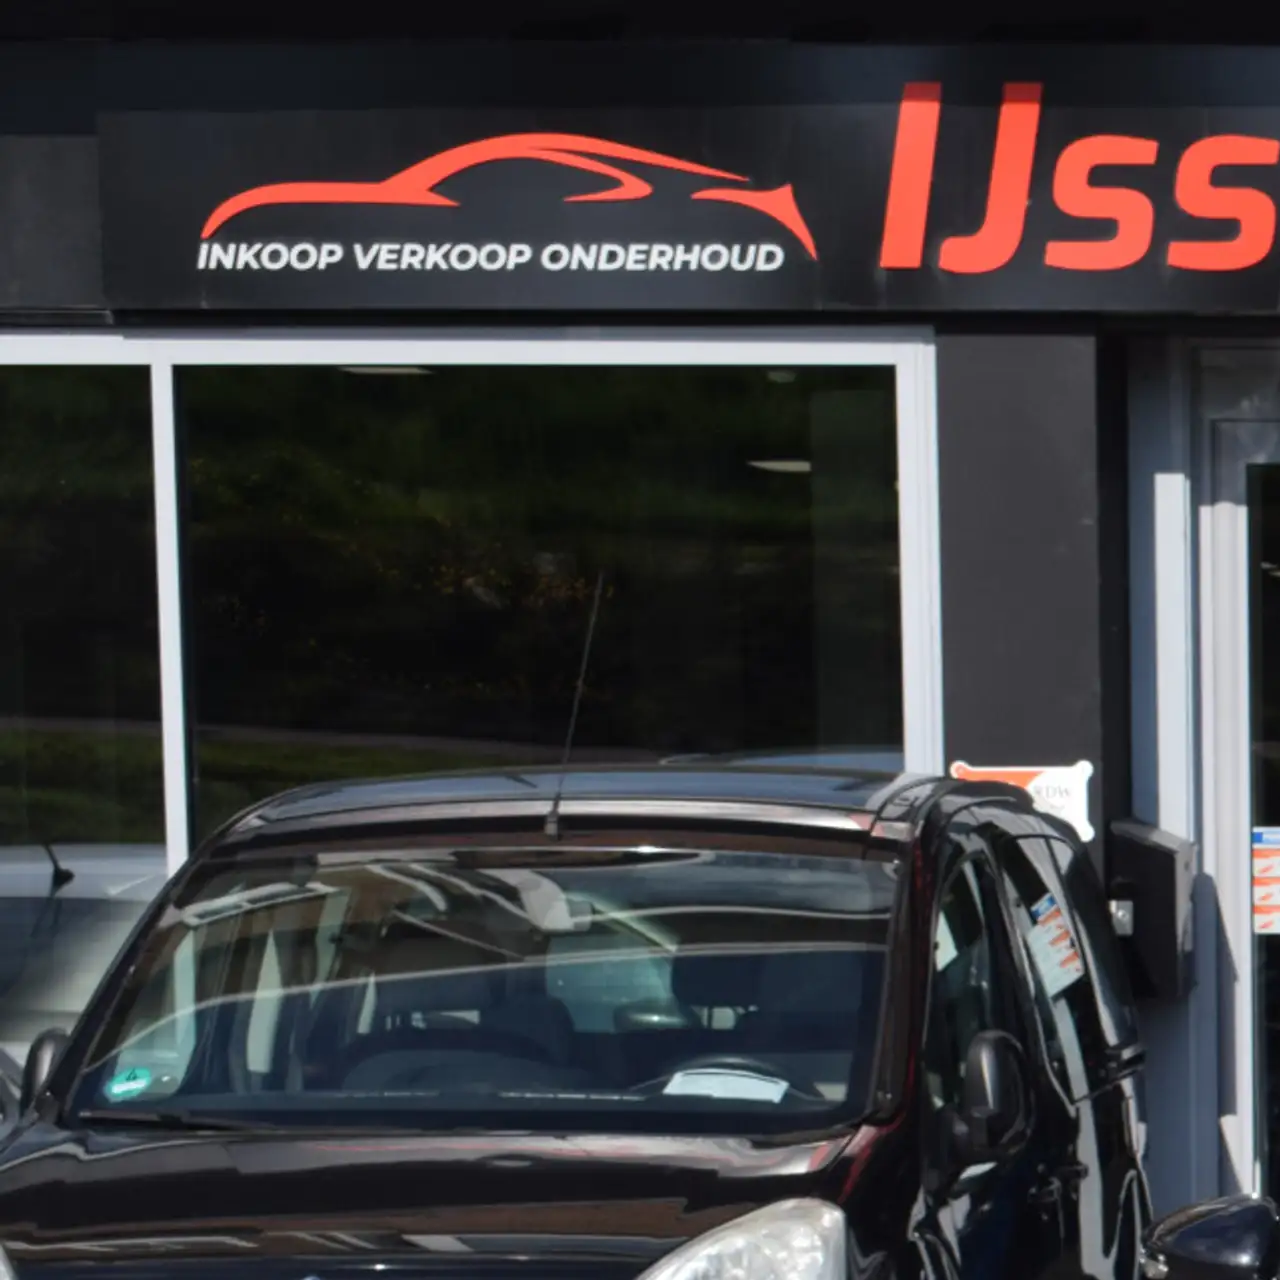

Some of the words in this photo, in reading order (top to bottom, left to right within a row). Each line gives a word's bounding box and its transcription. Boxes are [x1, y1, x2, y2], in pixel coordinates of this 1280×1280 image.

[197, 241, 344, 271] INKOOP
[353, 241, 533, 272] VERKOOP
[540, 241, 785, 272] ONDERHOUD
